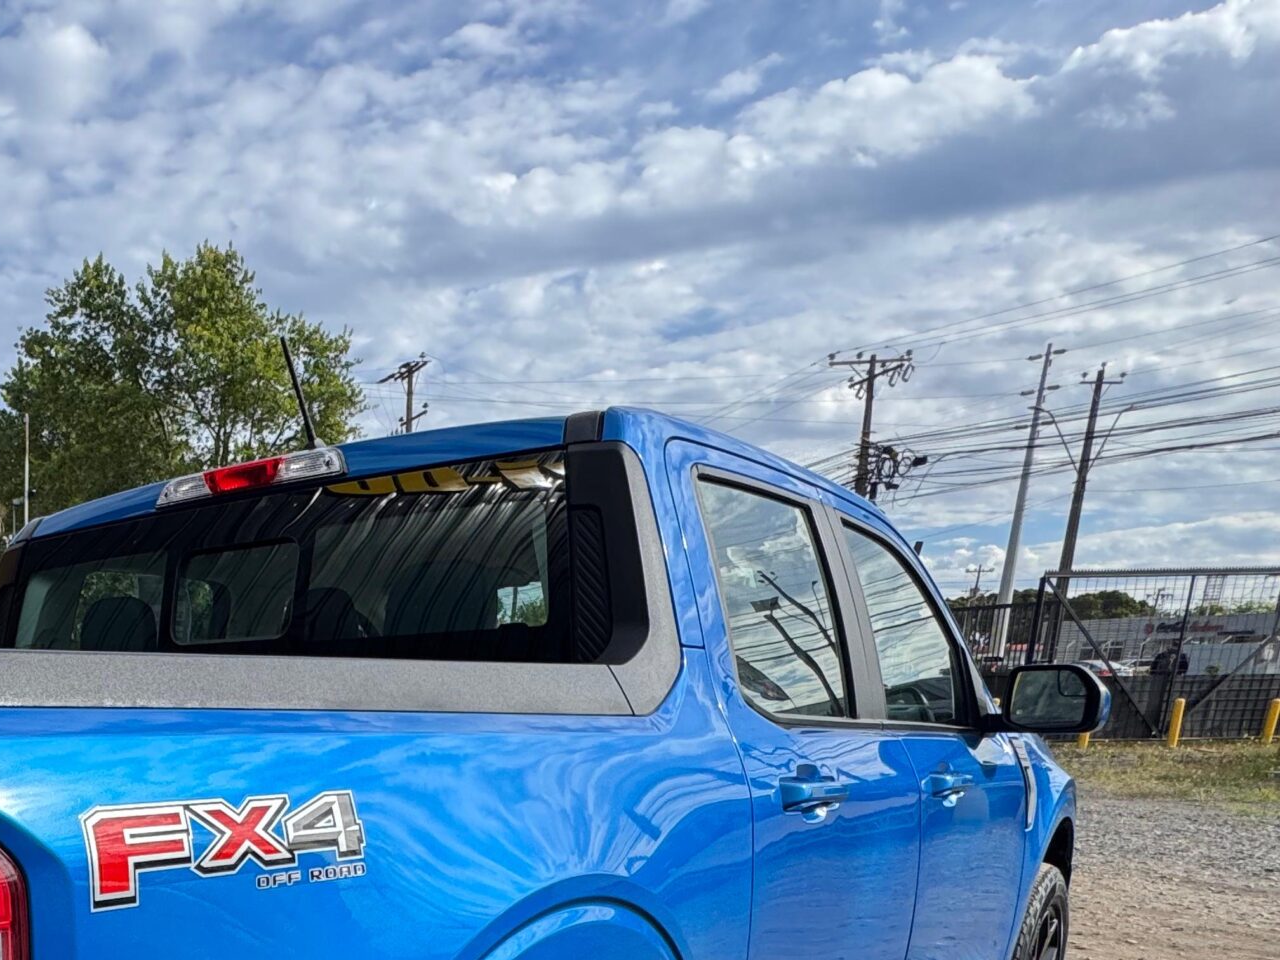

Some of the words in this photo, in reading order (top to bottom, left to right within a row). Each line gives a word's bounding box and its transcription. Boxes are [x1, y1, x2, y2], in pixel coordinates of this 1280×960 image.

[78, 789, 367, 913] FX4
[255, 869, 302, 890] OFF
[308, 862, 368, 883] ROAD
